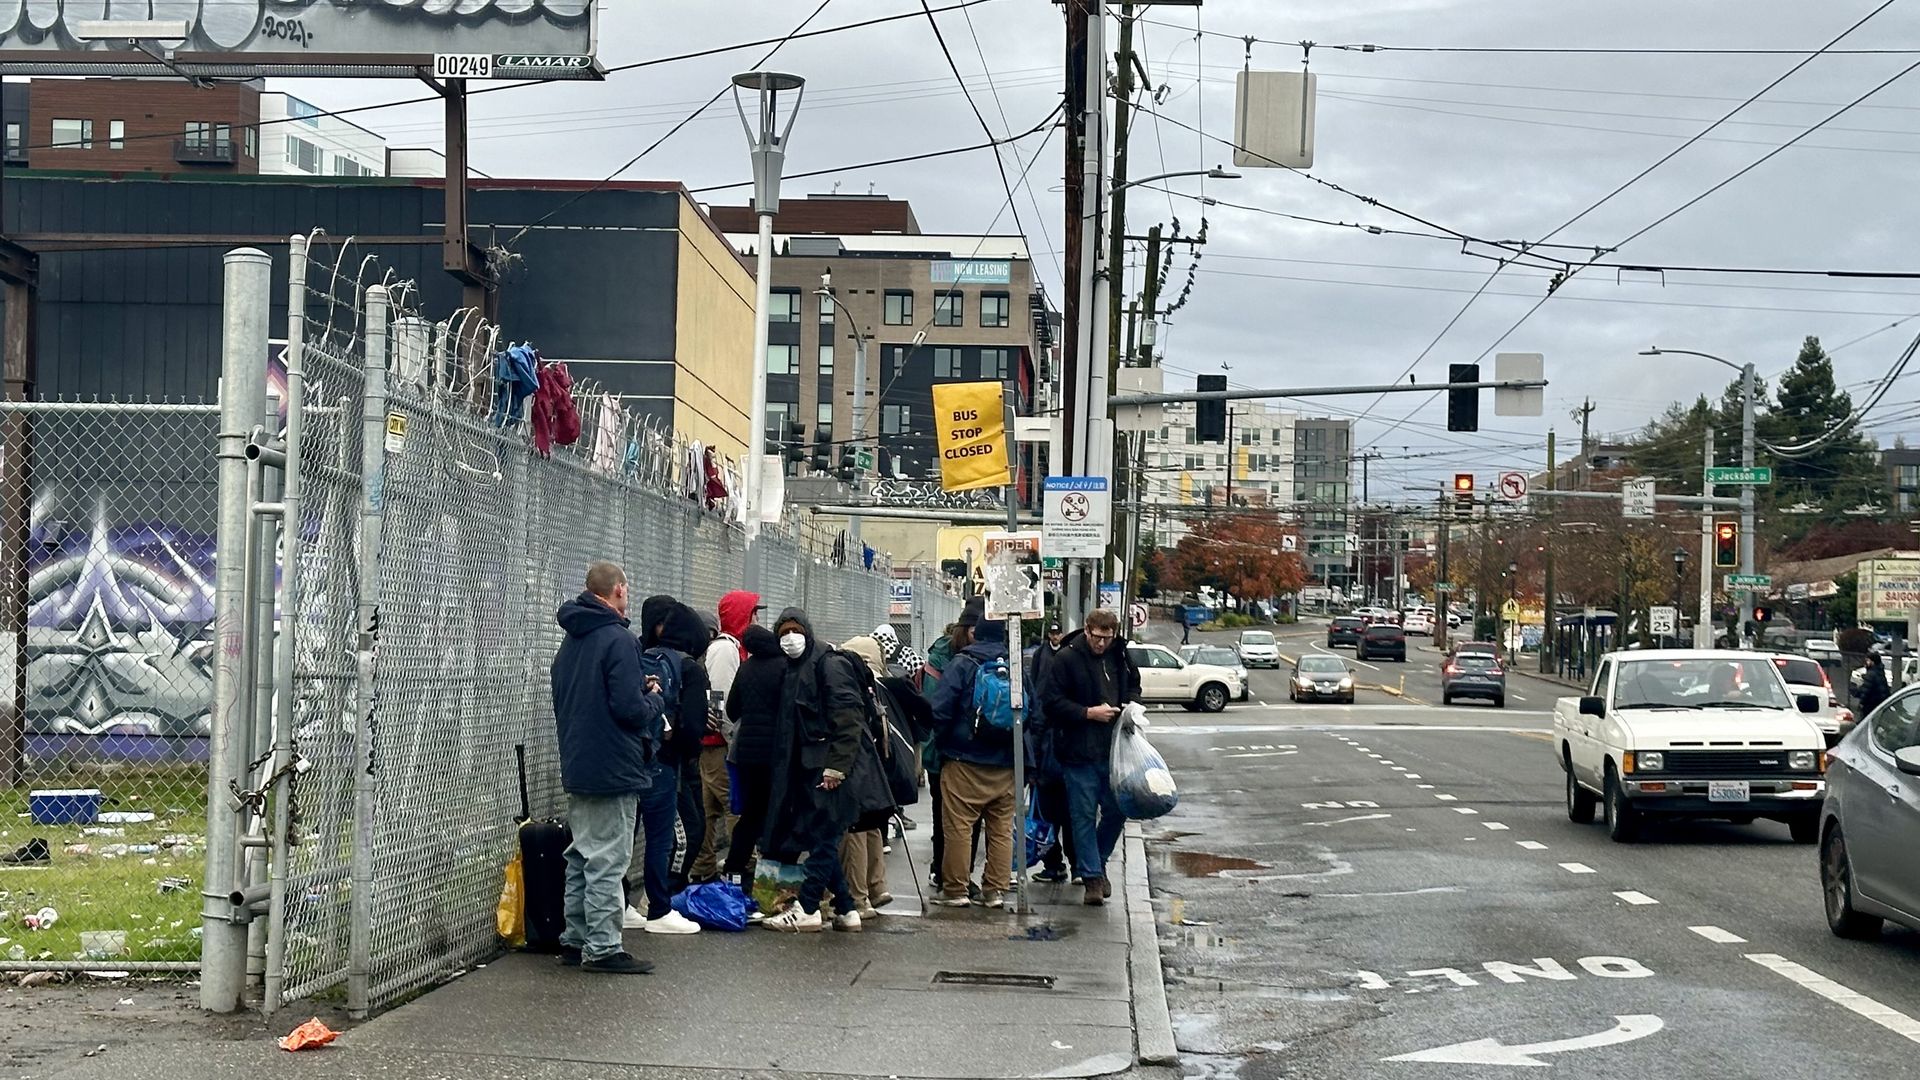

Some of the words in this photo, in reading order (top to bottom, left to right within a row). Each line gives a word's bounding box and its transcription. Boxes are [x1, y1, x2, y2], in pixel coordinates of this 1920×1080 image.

[438, 56, 489, 76] 00249
[504, 56, 582, 66] LAMAR
[954, 263, 973, 275] NOW
[975, 263, 1008, 276] LEASING
[953, 409, 978, 422] BUS
[951, 427, 983, 441] STOP
[944, 443, 993, 460] CLOSED
[1718, 471, 1755, 480] Jackson
[993, 539, 1033, 551] RIDER
[1653, 621, 1671, 632] 25
